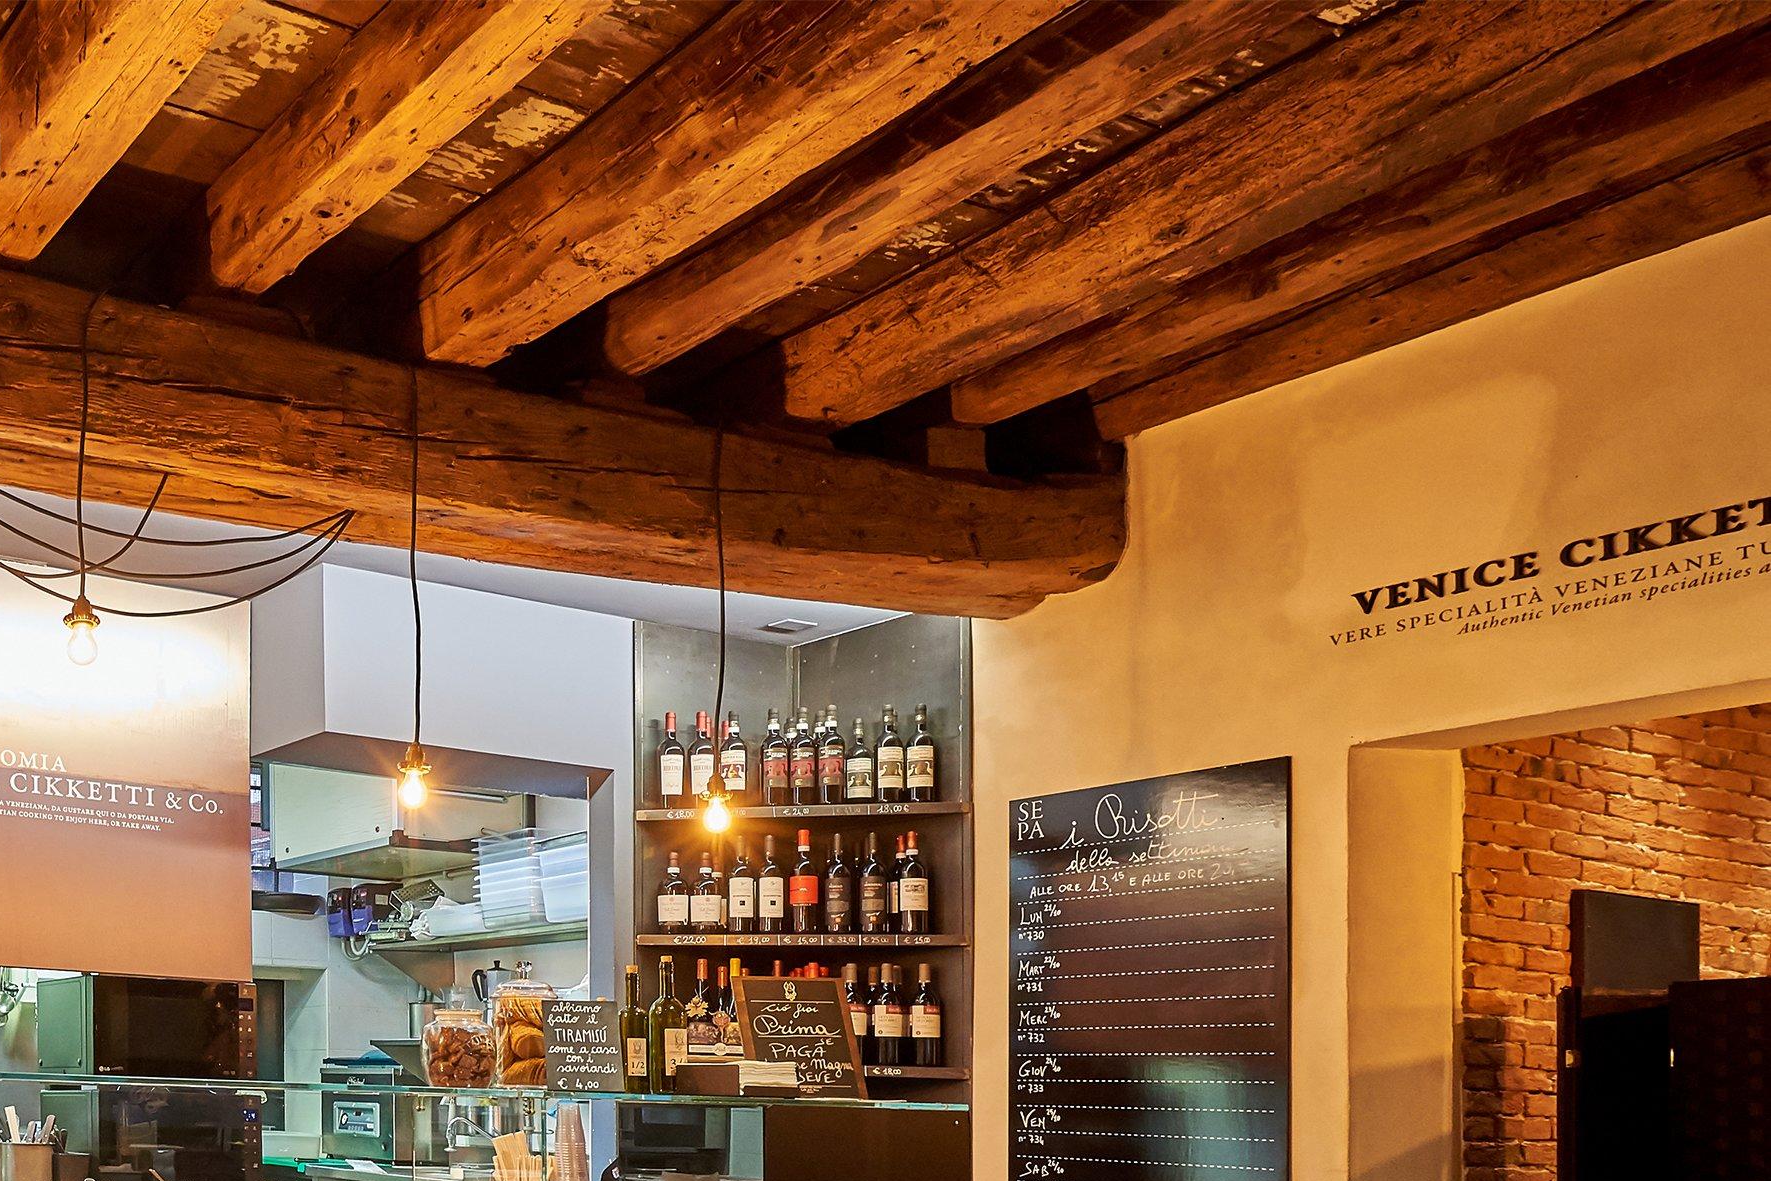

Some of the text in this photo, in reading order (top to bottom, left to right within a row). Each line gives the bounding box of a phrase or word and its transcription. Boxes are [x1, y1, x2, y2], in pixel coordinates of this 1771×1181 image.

[1351, 496, 1771, 615] VENICE CIKKET
[1329, 623, 1387, 646] VERE
[1395, 586, 1543, 633] SPECIALITÀ
[1554, 550, 1725, 599] VENEZIANE
[1457, 608, 1543, 636] Authentic
[1550, 592, 1632, 616] Venetian
[1639, 564, 1752, 601] specialities
[9, 772, 155, 807] CIKKETTI
[165, 792, 182, 810] &
[188, 793, 224, 815] Co.
[5, 800, 50, 812] VENEZIANA,
[63, 806, 95, 816] GUSTARE
[95, 810, 110, 818] QUI
[128, 813, 159, 823] PORTARE
[160, 816, 175, 824] VIA.
[18, 810, 53, 820] COOKING
[65, 816, 87, 825] ENJOY
[88, 818, 110, 827] HERE,
[121, 821, 140, 830] TAKE
[141, 823, 161, 831] AWAY.
[1018, 800, 1044, 821] SE
[1095, 790, 1219, 839] Risotti
[1017, 821, 1045, 841] PA
[1029, 886, 1054, 899] ALLE
[1058, 883, 1082, 893] ORE
[1129, 877, 1137, 887] E
[1141, 872, 1171, 887] ALLE
[1177, 868, 1204, 879] ORE
[551, 1001, 602, 1013] abbiamo
[547, 1013, 599, 1026] fatto il
[753, 1014, 841, 1035] Prima
[547, 1045, 618, 1054] come a casa
[566, 1053, 594, 1064] con i
[769, 1042, 826, 1058] PAGA
[556, 1062, 618, 1074] savoiardi
[631, 1061, 645, 1069] 1/2
[810, 1058, 854, 1078] Magna
[557, 1077, 599, 1090] € 4,00
